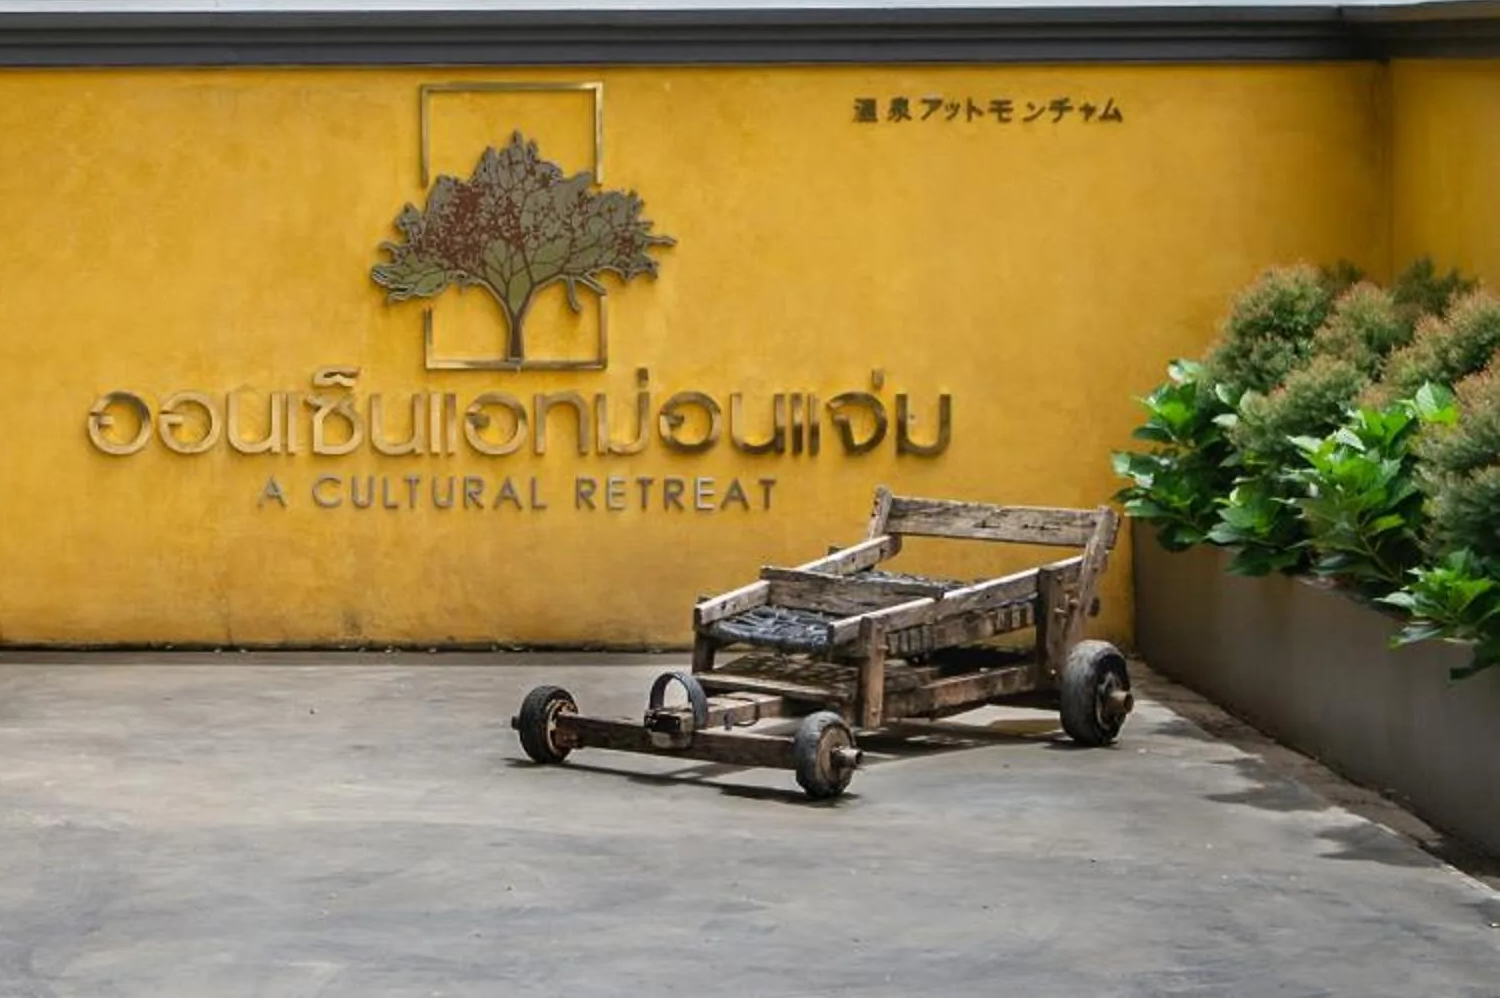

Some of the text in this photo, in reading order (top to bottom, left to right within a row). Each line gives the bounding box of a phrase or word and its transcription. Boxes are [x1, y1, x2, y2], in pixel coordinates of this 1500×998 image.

[258, 475, 778, 511] A CULTURAL RETREAT
